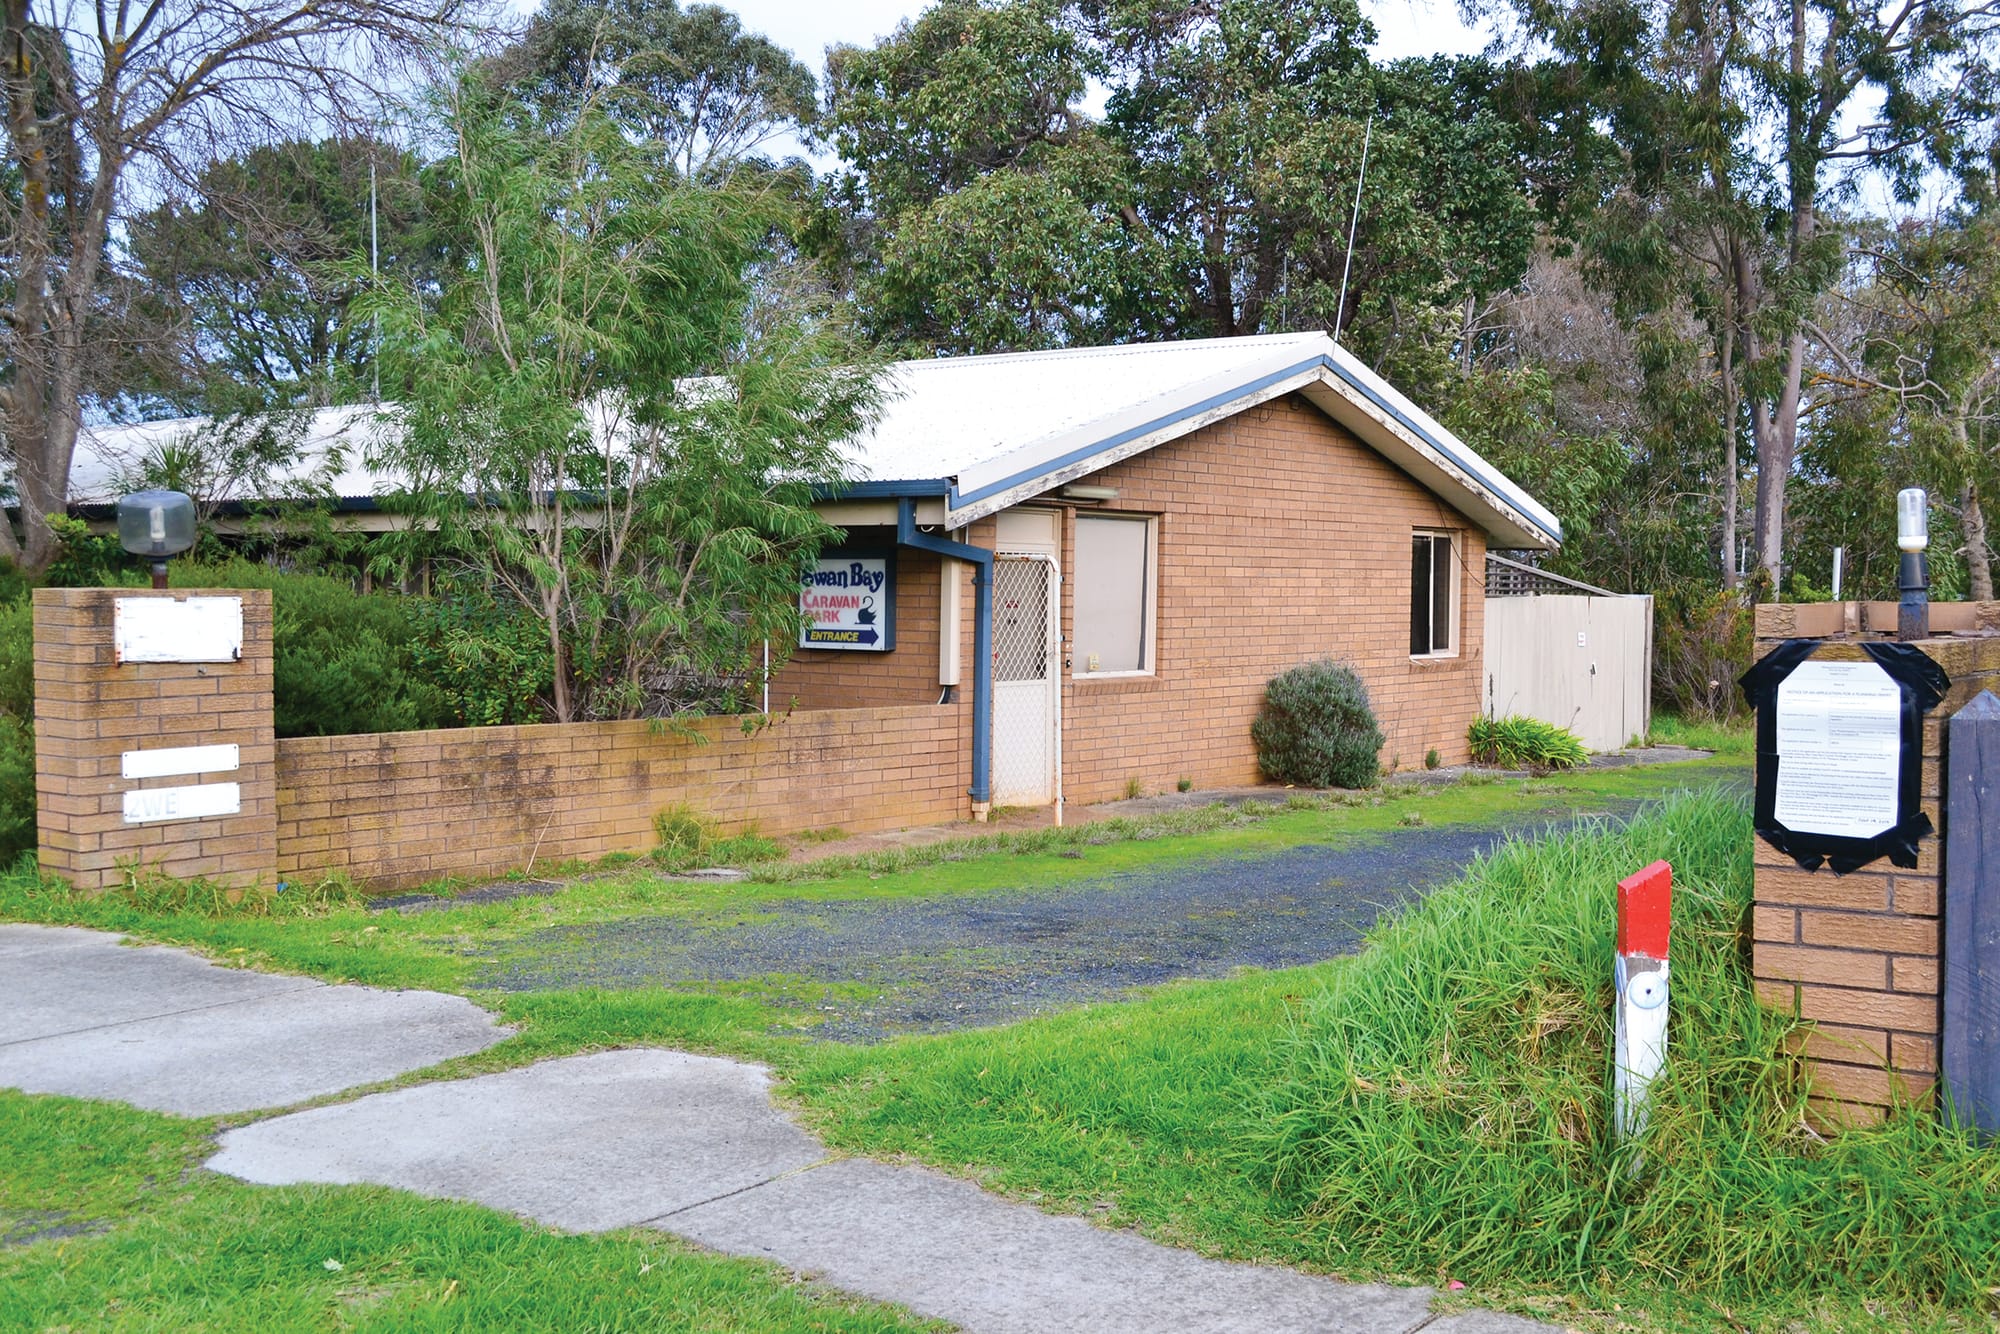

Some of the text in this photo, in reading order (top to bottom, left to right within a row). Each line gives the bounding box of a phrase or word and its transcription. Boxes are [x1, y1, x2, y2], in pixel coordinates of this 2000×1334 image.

[849, 562, 884, 593] Bay
[802, 588, 860, 609] CARAVAN
[810, 631, 859, 641] ENTRANCE
